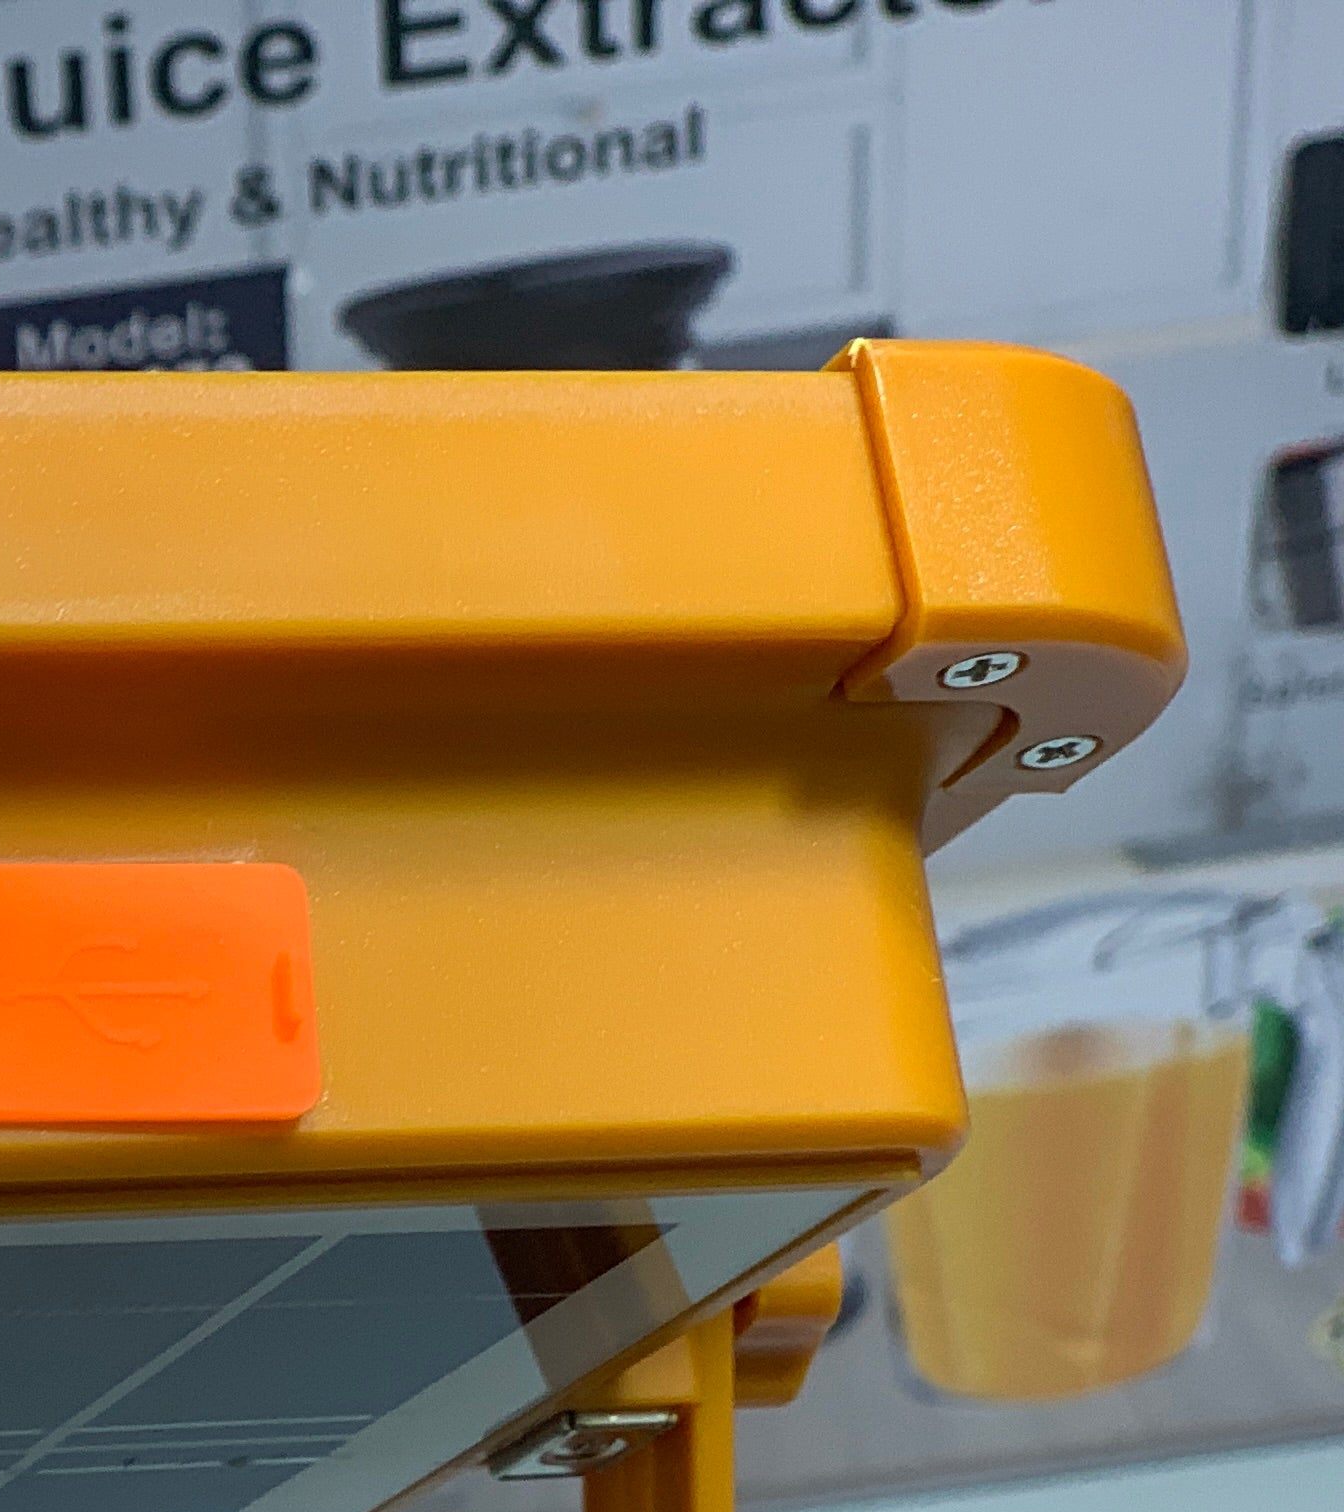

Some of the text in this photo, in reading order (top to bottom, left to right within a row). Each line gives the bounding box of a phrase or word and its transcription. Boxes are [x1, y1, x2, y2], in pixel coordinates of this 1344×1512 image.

[230, 162, 281, 228] &
[309, 102, 708, 214] Nutritional
[14, 302, 233, 370] Model:
